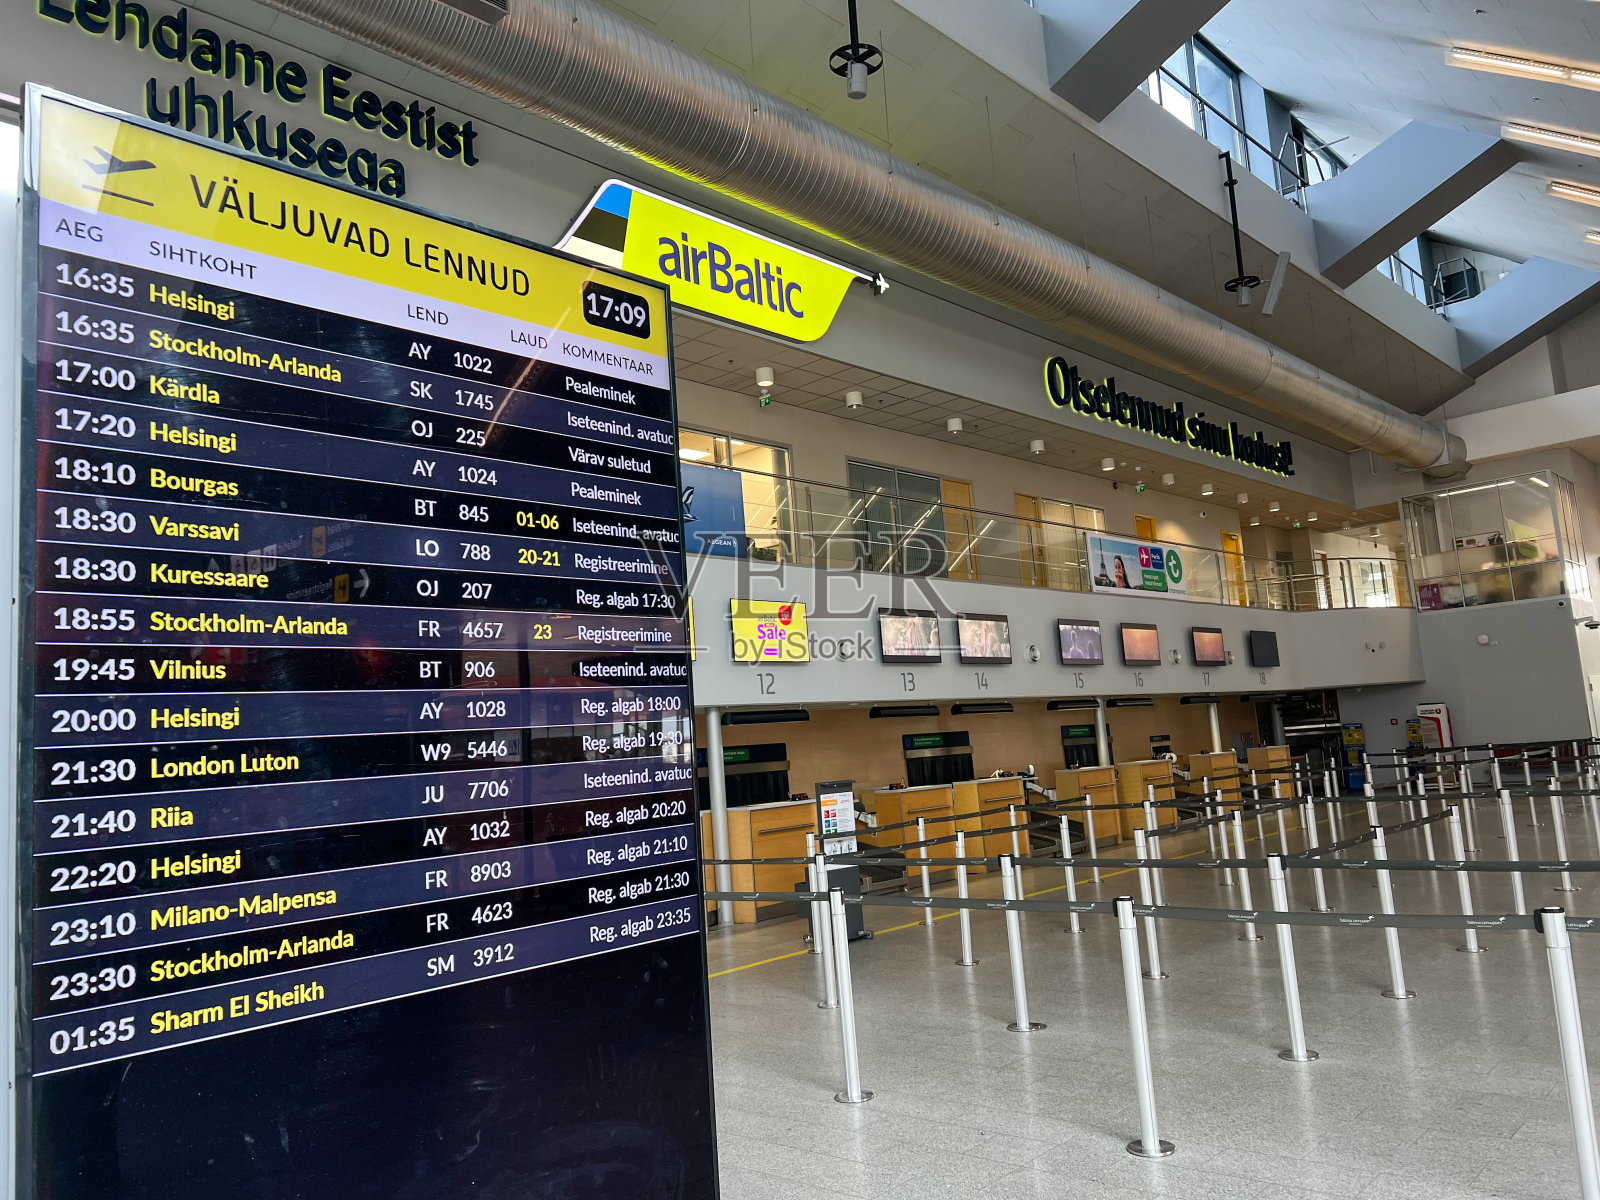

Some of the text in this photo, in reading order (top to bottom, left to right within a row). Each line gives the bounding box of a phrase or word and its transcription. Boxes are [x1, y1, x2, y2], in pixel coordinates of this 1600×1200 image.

[145, 77, 406, 199] uhkusega
[321, 64, 479, 166] Eestist
[189, 174, 530, 297] VÄLJUVAD LENNUD
[55, 217, 654, 375] AEG SIHTKOHT LEND LAUD KOMMENTAAR
[658, 232, 804, 319] airBaltic
[56, 262, 636, 405] 16:35 Helsingi AY 1022 Pealeminek
[586, 293, 646, 328] 17:09
[56, 310, 135, 344] 16:35
[149, 329, 341, 383] Stockholm-Arlanda
[410, 381, 433, 400] SK
[454, 389, 494, 411] 1745
[567, 411, 634, 438] Iseteenind.
[55, 359, 651, 474] 17:00 Kärdla OJ 225 Värav suletud
[55, 407, 642, 505] 17:20 Helsingi AY 1024 Pealeminek
[54, 456, 136, 485] 18:10
[150, 468, 239, 497] Bourgas
[414, 499, 437, 517] BT
[459, 504, 489, 523] 845
[516, 511, 560, 530] 01-06
[573, 518, 640, 539] Iseteenind.
[54, 506, 668, 575] 18:30 Varssavi LO 788 20-21 Registreerimine
[707, 538, 732, 546] AEGEAN
[54, 556, 675, 610] 18:30 Kuressaare OJ 207 Reg. algab 17:30
[53, 607, 672, 643] 18:55 Stockholm-Arlanda FR 4657 23 Registreerimine
[757, 624, 786, 640] Sale
[53, 658, 135, 681] 19:45
[149, 659, 226, 680] Vilnius
[419, 661, 442, 679] BT
[464, 661, 495, 678] 906
[579, 662, 647, 677] Iseteenind.
[757, 672, 775, 695] 12
[900, 672, 915, 691] 13
[975, 672, 989, 690] 14
[1073, 672, 1084, 689] 15
[1133, 672, 1143, 687] 16
[1202, 672, 1210, 686] 17
[1259, 672, 1266, 685] 18
[51, 696, 681, 733] 20:00 Helsingi AY 1028 Reg. algab 18:00
[51, 731, 683, 785] 21:30 London Luton W9 5446 Reg. algab 19:30
[50, 809, 136, 838] 21:40
[151, 806, 193, 828] Riia
[422, 785, 444, 804] JU
[468, 780, 509, 799] 7706
[584, 768, 652, 789] Iseteenind.
[50, 800, 686, 892] 22:20 Helsingi AY 1032 Reg. algab 20:20
[50, 835, 688, 946] 23:10 Milano-Malpensa FR 8903 Reg. algab 21:10
[50, 871, 690, 1000] 23:30 Stockholm-Arlanda FR 4623 Reg. algab 21:30
[50, 907, 691, 1055] 01:35 Sharm El Sheikh SM 3912 Reg. algab 23:35
